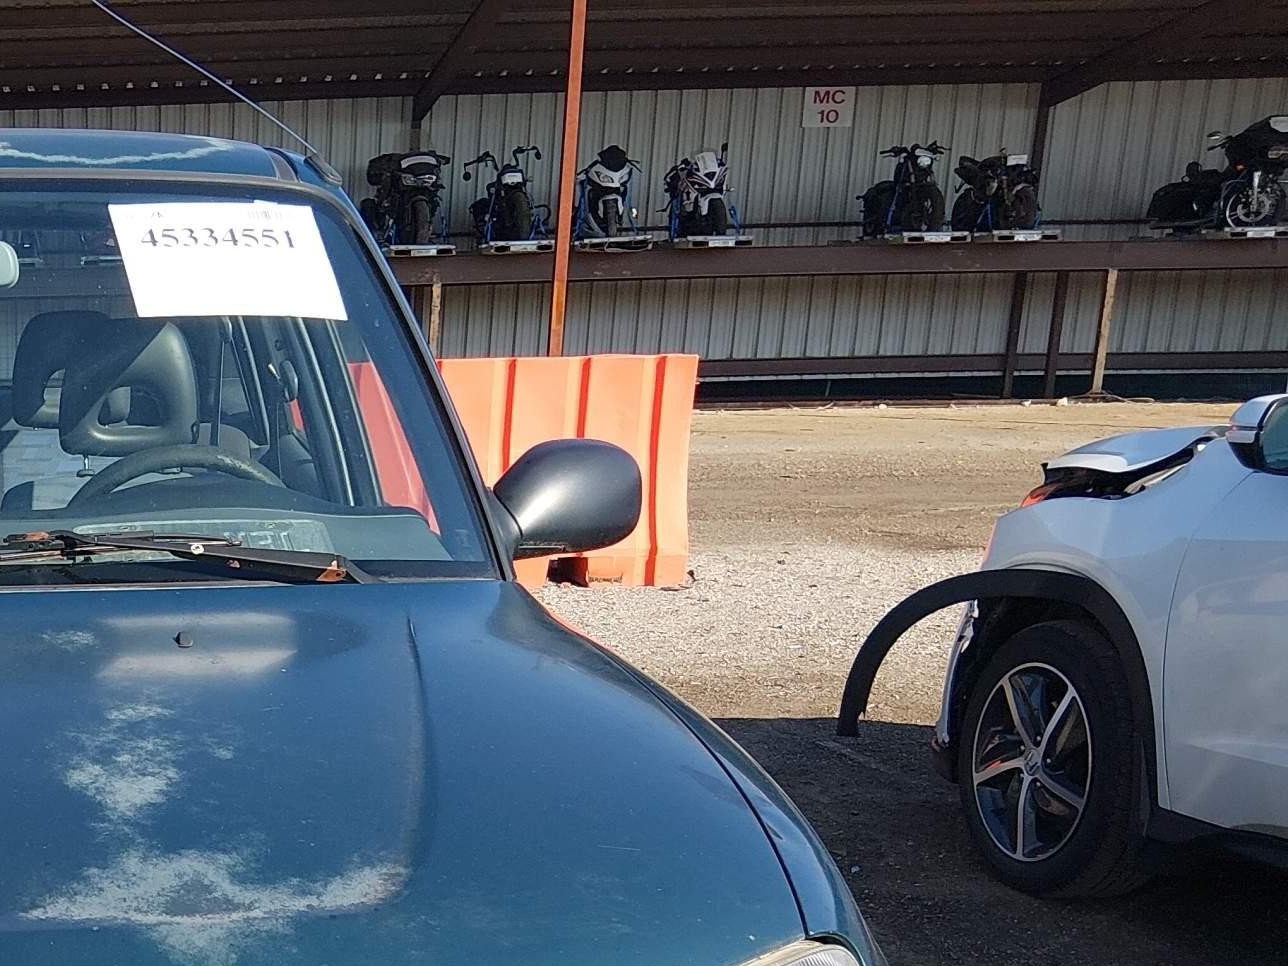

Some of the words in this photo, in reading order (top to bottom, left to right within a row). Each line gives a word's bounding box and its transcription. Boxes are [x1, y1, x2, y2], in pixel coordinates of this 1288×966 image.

[813, 90, 846, 104] MC
[817, 109, 839, 123] 10
[140, 227, 295, 249] 45334551
